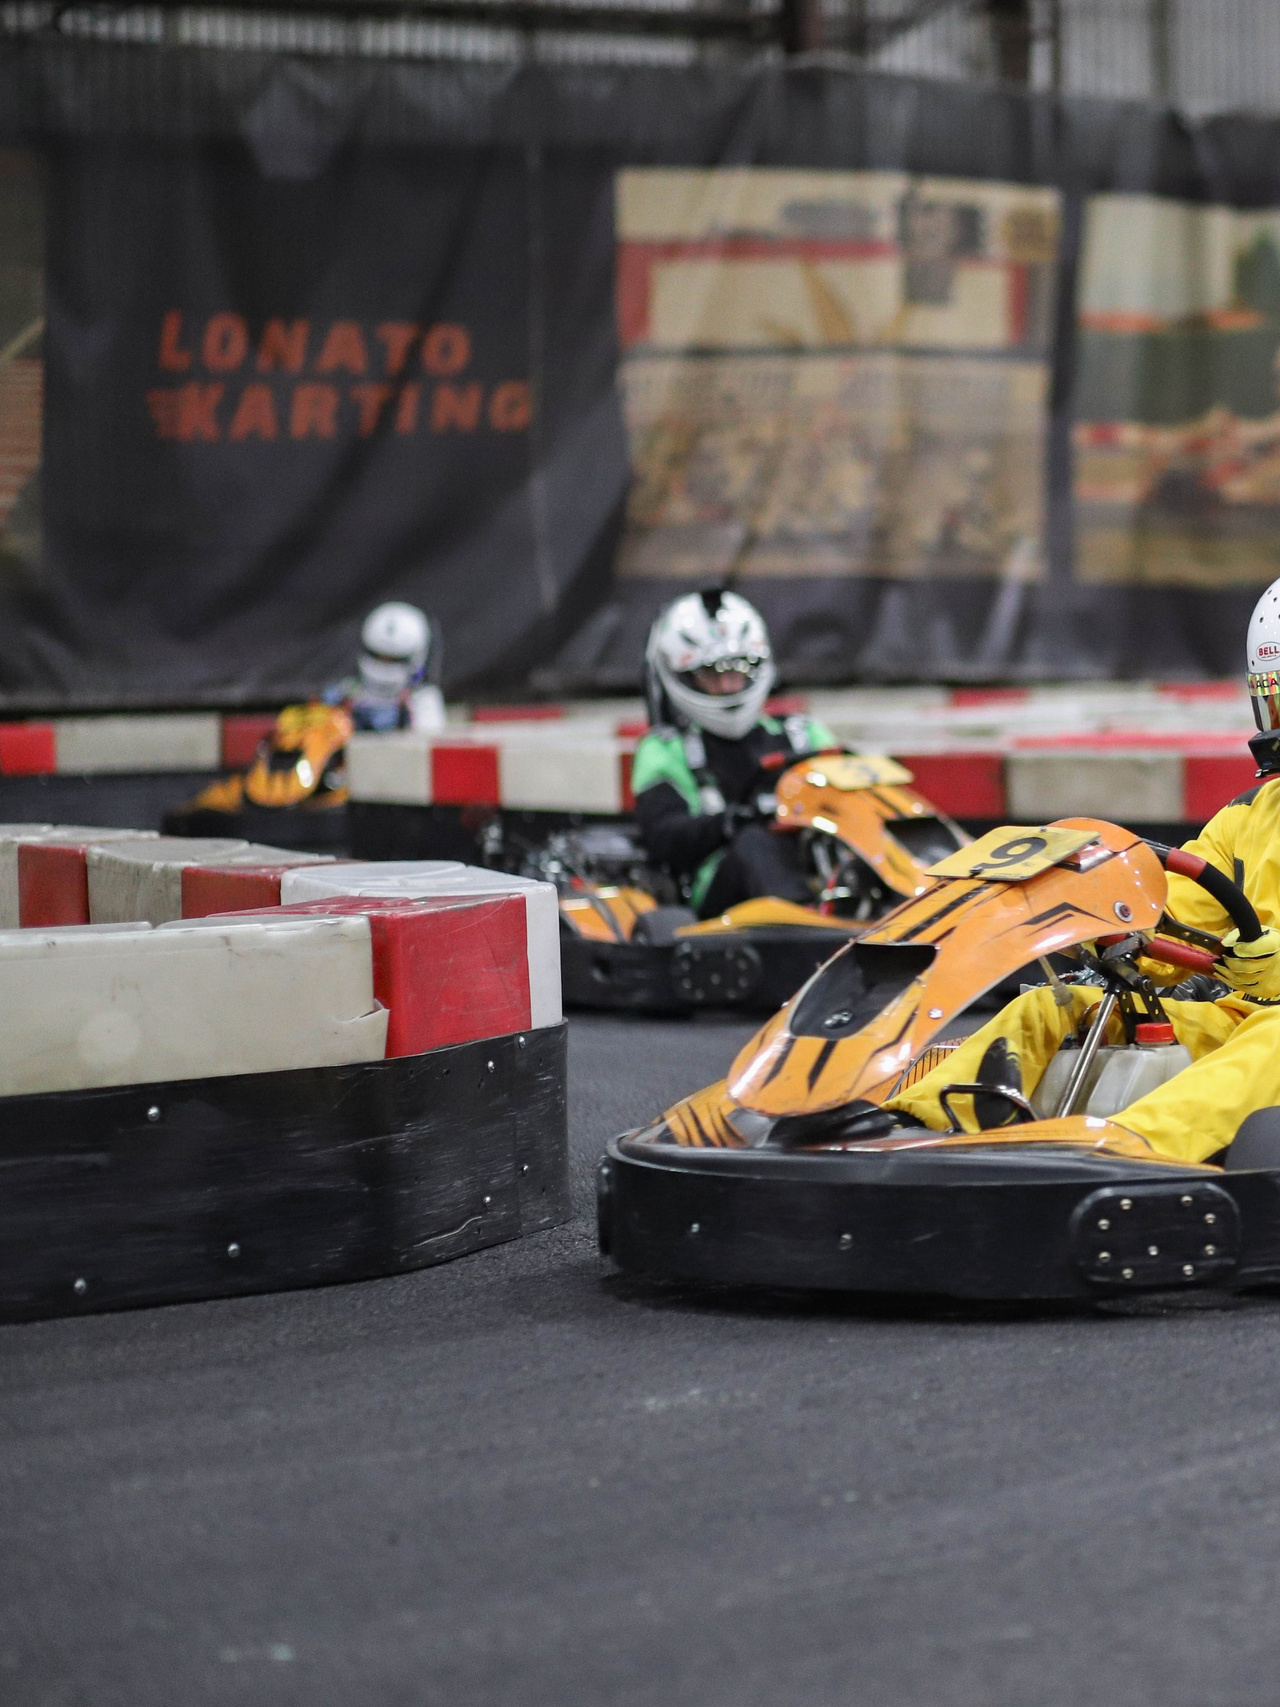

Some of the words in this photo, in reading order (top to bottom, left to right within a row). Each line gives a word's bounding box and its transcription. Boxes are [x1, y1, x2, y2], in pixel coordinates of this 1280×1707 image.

[157, 308, 472, 376] LONATO
[174, 380, 533, 444] KARTING
[1259, 645, 1280, 657] BELL
[977, 836, 1048, 870] 9
